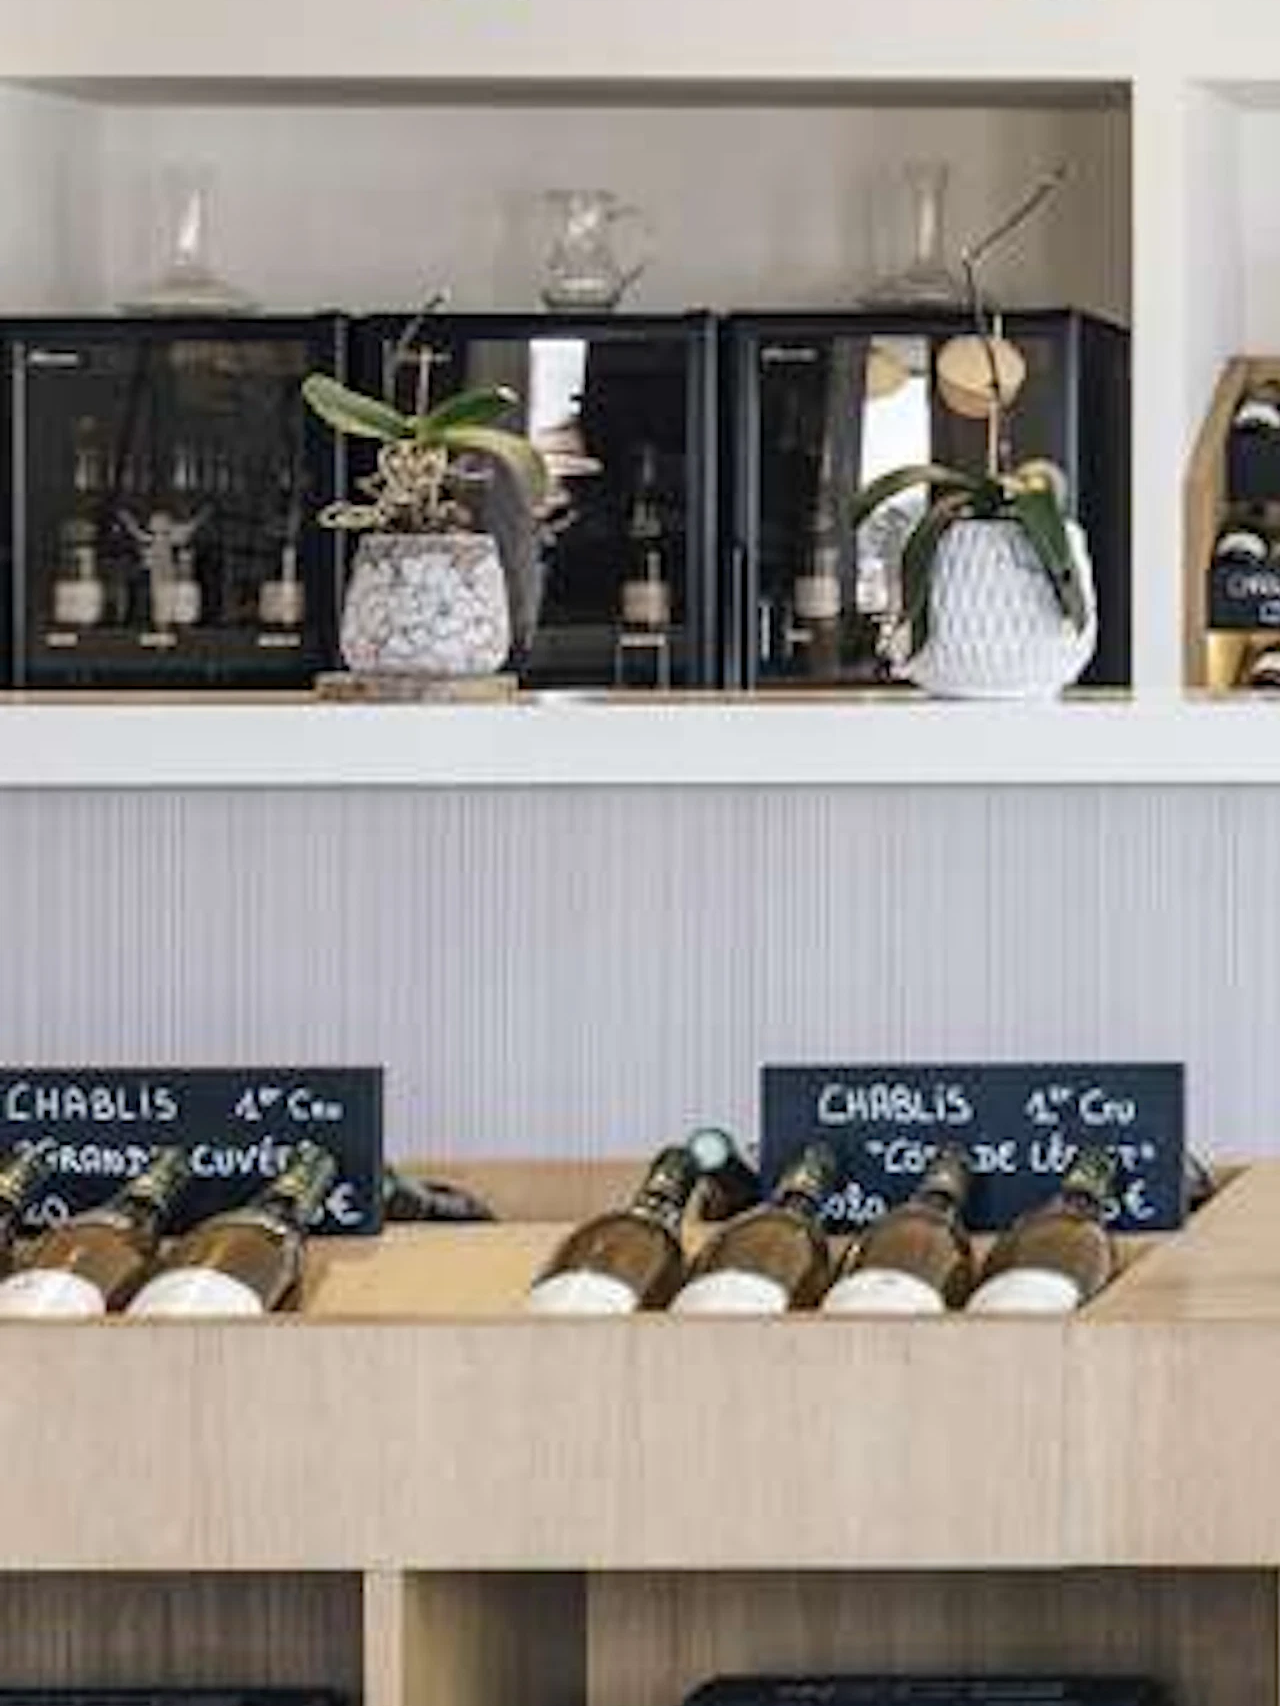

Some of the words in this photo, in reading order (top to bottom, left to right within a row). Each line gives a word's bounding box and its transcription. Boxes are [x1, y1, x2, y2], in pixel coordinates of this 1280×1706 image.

[6, 1082, 179, 1122] CHABLIS
[818, 1082, 974, 1124] CHABLIS
[970, 1141, 1017, 1173] DE
